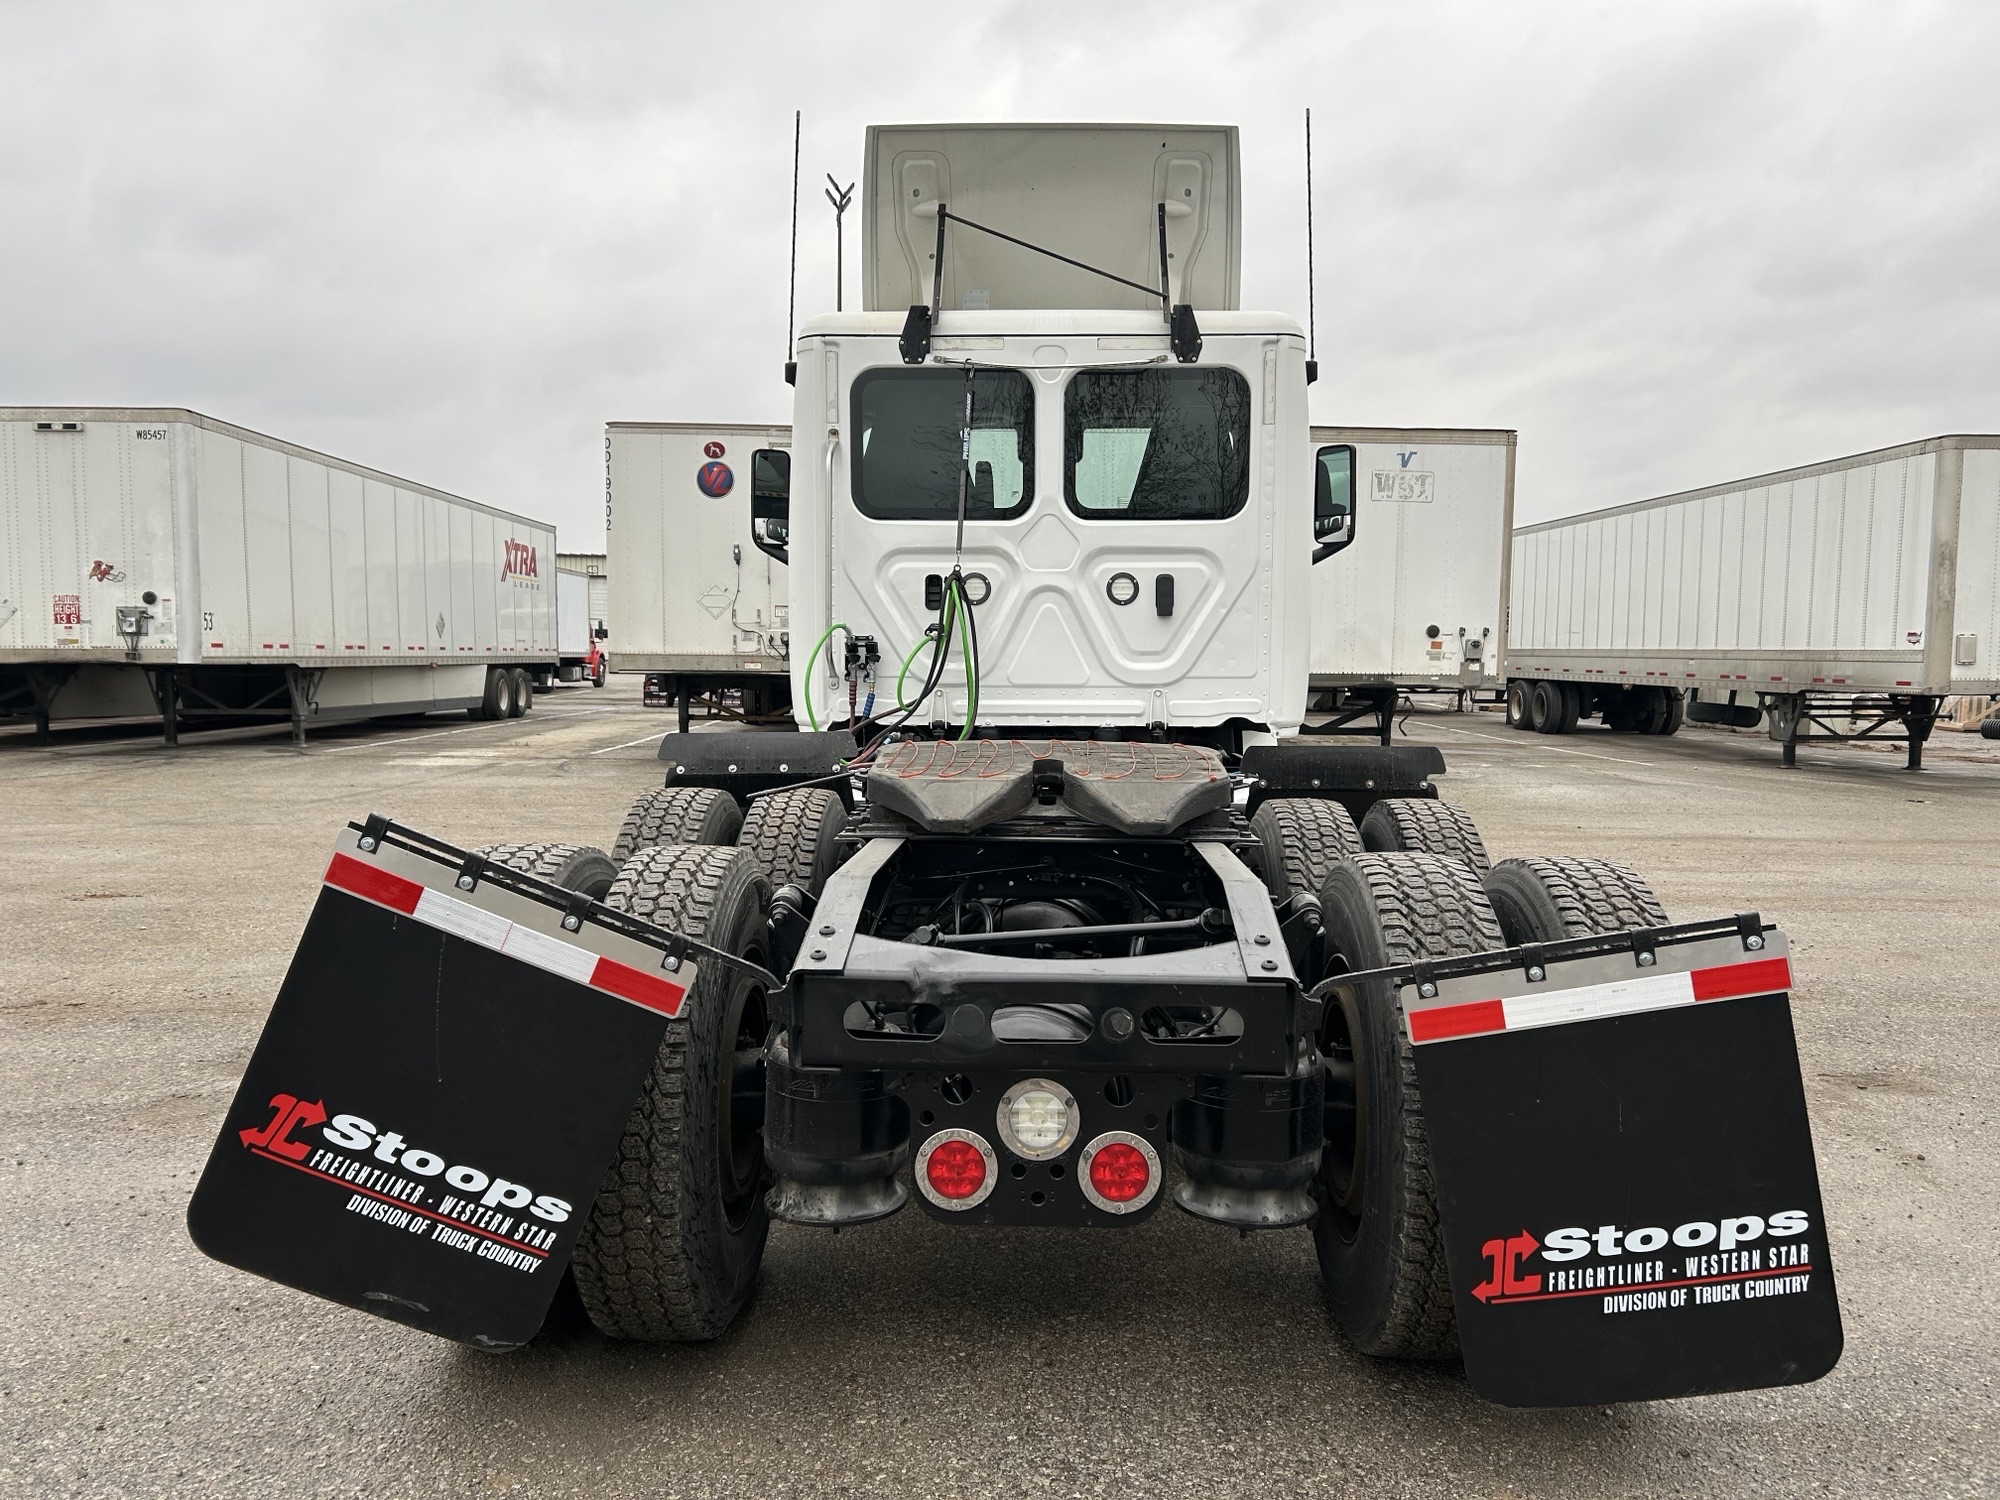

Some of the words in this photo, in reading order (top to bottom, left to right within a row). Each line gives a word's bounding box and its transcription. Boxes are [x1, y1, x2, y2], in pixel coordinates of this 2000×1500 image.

[136, 429, 167, 440] W85457
[500, 538, 538, 582] XTRA
[587, 566, 598, 574] 48
[53, 594, 80, 602] CAUTION
[513, 580, 540, 591] LEASE
[54, 604, 80, 614] HEIGHT
[323, 1114, 572, 1222] Stoops
[309, 1149, 425, 1204] FREIGHTLINER
[437, 1195, 514, 1235] WESTERN
[513, 1222, 557, 1250] STAR
[346, 1194, 411, 1231] DIVISION
[408, 1214, 431, 1235] OF
[431, 1223, 479, 1253] TRUCK
[476, 1240, 542, 1274] COUNTRY
[1541, 1210, 1809, 1262] Stoops
[1549, 1261, 1664, 1292] FREIGHTLINER
[1685, 1249, 1761, 1278] WESTERN
[1768, 1243, 1809, 1269] STAR
[1603, 1291, 1667, 1314] DIVISION
[1670, 1289, 1687, 1308] OF
[1694, 1283, 1741, 1305] TRUCK
[1745, 1275, 1810, 1299] COUNTRY
